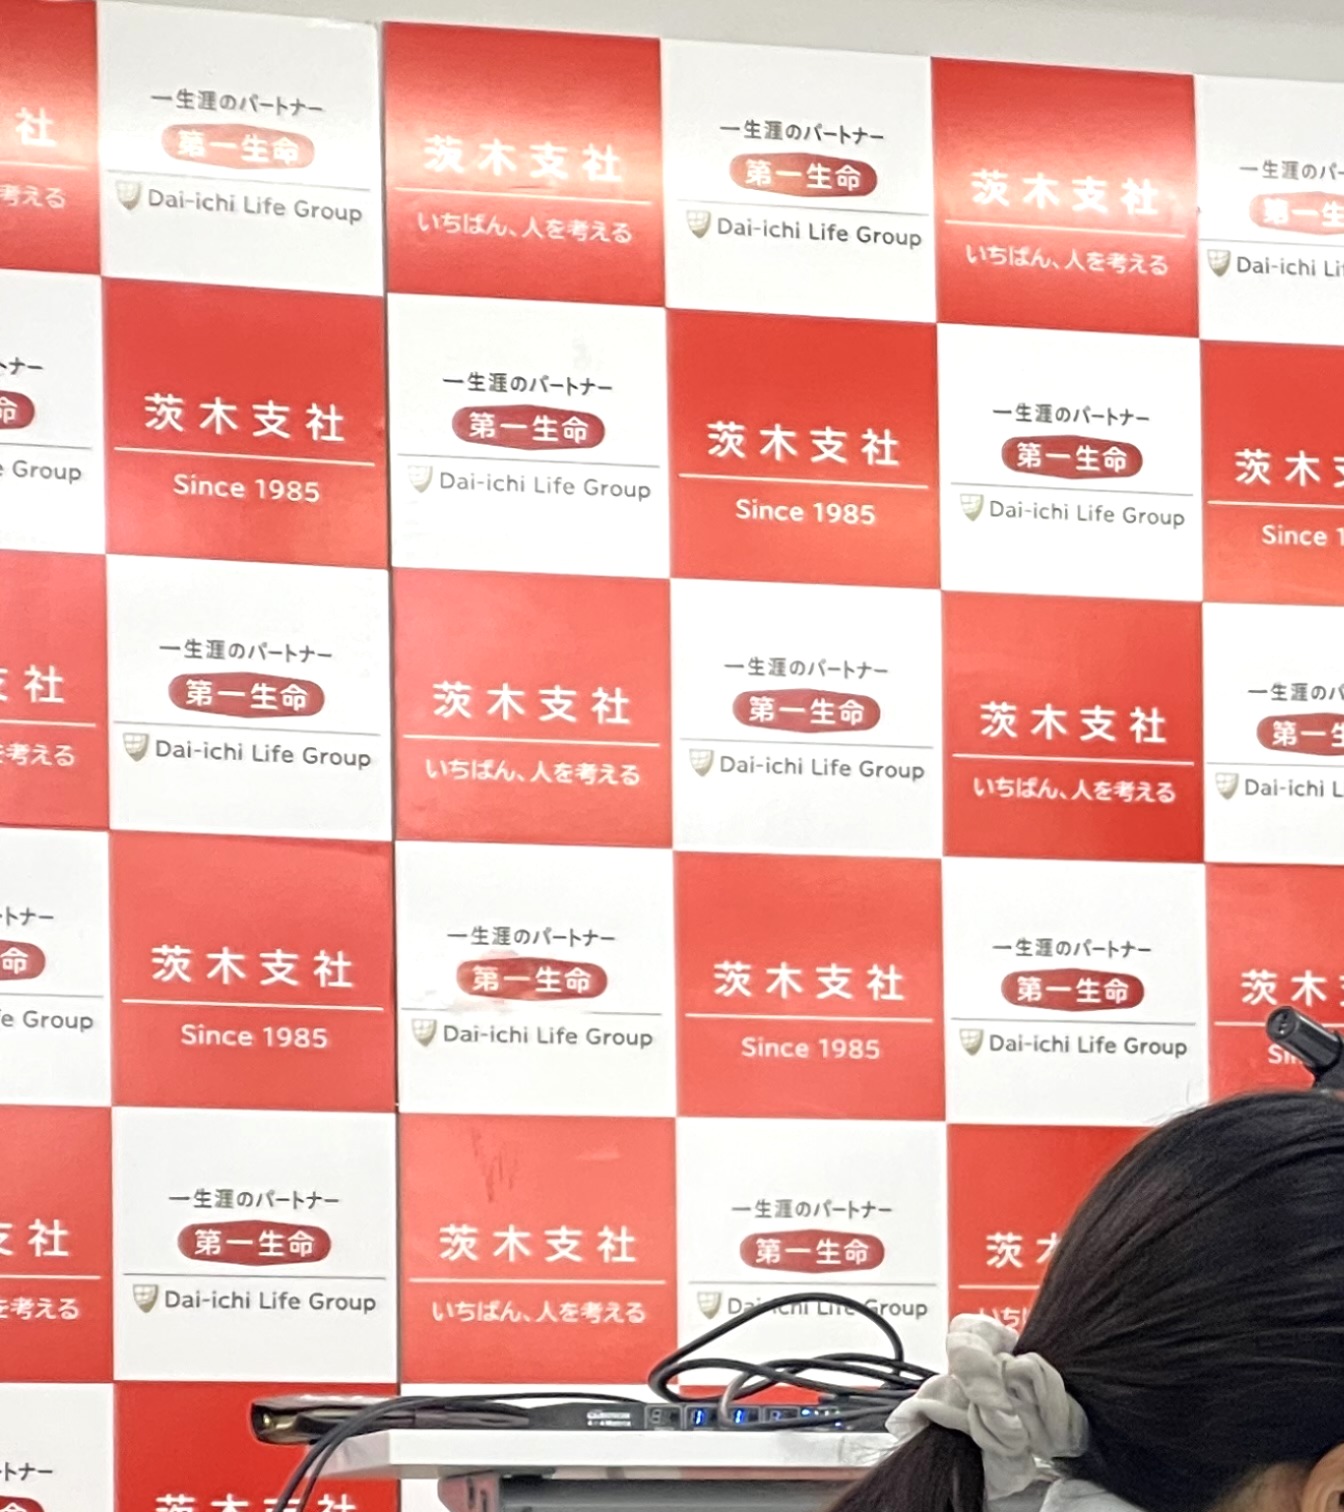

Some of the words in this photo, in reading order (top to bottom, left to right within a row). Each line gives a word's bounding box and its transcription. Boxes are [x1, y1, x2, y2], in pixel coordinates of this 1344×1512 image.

[150, 87, 324, 117] 一生涯のパートナー
[719, 118, 884, 146] 一生涯のパートナー
[176, 128, 302, 166] 第一生命
[423, 134, 628, 186] 茨木支社
[745, 159, 862, 192] 第一生命
[970, 167, 1160, 216] 茨木支社
[148, 188, 235, 213] Dai-ichi
[243, 195, 287, 217] Life
[293, 199, 363, 226] Group
[417, 212, 633, 244] いちばん、人を考える
[717, 217, 801, 240] Dai-ichi
[808, 222, 849, 243] Life
[856, 225, 922, 250] Group
[965, 244, 1169, 277] いちばん、人を考える
[1236, 255, 1317, 277] Dai-ichi
[442, 371, 613, 397] 一生涯のパートナー
[144, 392, 345, 442] 茨木支社
[469, 411, 589, 445] 第一生命
[992, 402, 1150, 427] 一生涯のパートナー
[706, 420, 900, 466] 茨木支社
[1016, 441, 1128, 473] 第一生命
[12, 459, 82, 485] Group
[173, 473, 247, 499] Since
[254, 478, 321, 503] 1985
[440, 471, 525, 493] Dai-ichi
[534, 476, 576, 496] Life
[583, 478, 652, 503] Group
[735, 498, 805, 522] Since
[812, 502, 877, 526] 1985
[989, 500, 1069, 521] Dai-ichi
[1076, 504, 1115, 524] Life
[1122, 506, 1186, 530] Group
[1262, 524, 1328, 547] Since
[159, 638, 333, 664] 一生涯のパートナー
[723, 656, 889, 680] 一生涯のパートナー
[185, 678, 309, 712] 第一生命
[432, 680, 631, 725] 茨木支社
[748, 695, 865, 726] 第一生命
[980, 700, 1167, 744] 茨木支社
[155, 739, 243, 761] Dai-ichi
[252, 744, 295, 764] Life
[302, 746, 372, 771] Group
[720, 755, 803, 776] Dai-ichi
[811, 758, 852, 778] Life
[858, 759, 925, 782] Group
[425, 758, 641, 787] いちばん、人を考える
[973, 776, 1177, 804] いちばん、人を考える
[1244, 778, 1325, 798] Dai-ichi
[446, 925, 616, 948] 一生涯のパートナー
[992, 937, 1152, 959] 一生涯のパートナー
[151, 943, 354, 988] 茨木支社
[472, 965, 593, 994] 第一生命
[713, 959, 905, 1002] 茨木支社
[1017, 975, 1130, 1005] 第一生命
[22, 1010, 94, 1033] Group
[181, 1023, 255, 1047] Since
[262, 1026, 329, 1049] 1985
[443, 1024, 529, 1044] Dai-ichi
[536, 1026, 578, 1045] Life
[585, 1027, 654, 1050] Group
[741, 1036, 810, 1059] Since
[818, 1038, 881, 1060] 1985
[989, 1033, 1070, 1053] Dai-ichi
[1077, 1035, 1117, 1055] Life
[1123, 1036, 1188, 1060] Group
[168, 1187, 340, 1210] 一生涯のパートナー
[731, 1198, 893, 1220] 一生涯のパートナー
[194, 1228, 316, 1258] 第一生命
[439, 1223, 637, 1264] 茨木支社
[755, 1237, 870, 1265] 第一生命
[164, 1289, 251, 1310] Dai-ichi
[259, 1291, 302, 1311] Life
[308, 1292, 377, 1315] Group
[432, 1299, 647, 1325] いちばん、人を考える
[864, 1298, 928, 1320] Group
